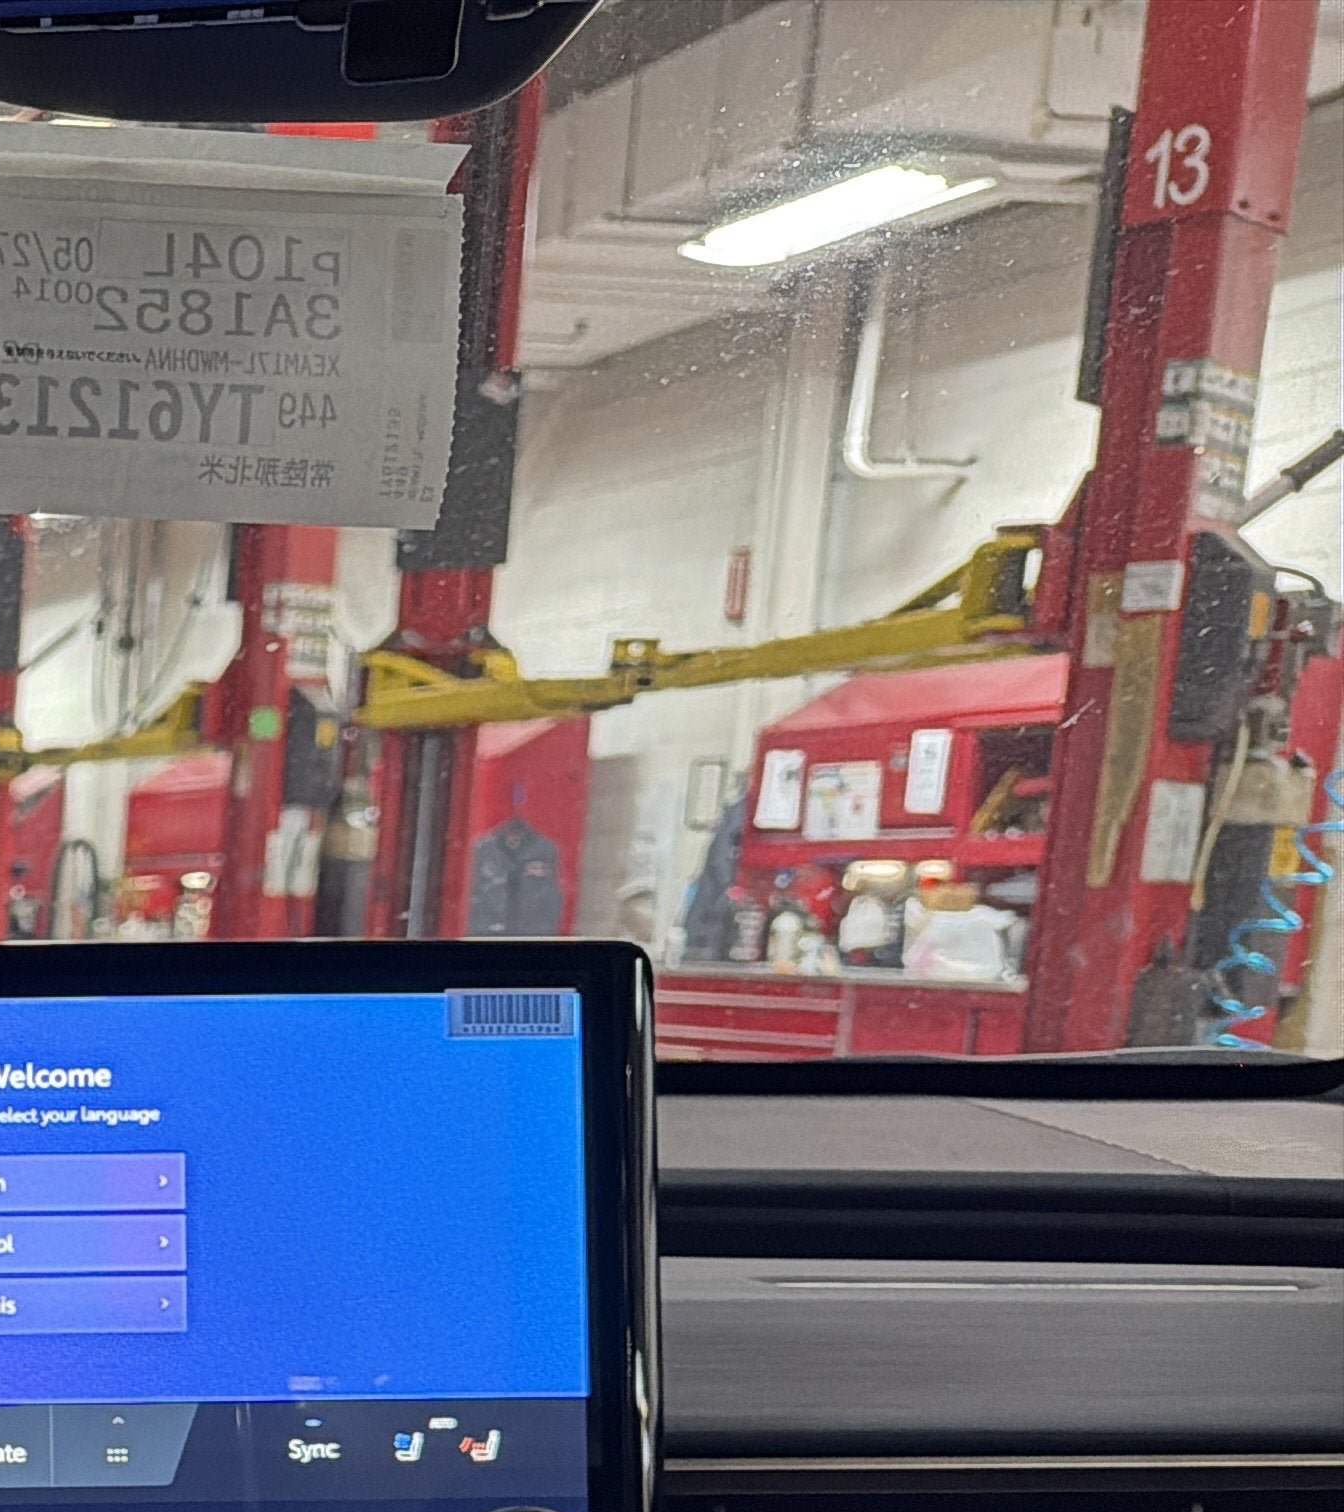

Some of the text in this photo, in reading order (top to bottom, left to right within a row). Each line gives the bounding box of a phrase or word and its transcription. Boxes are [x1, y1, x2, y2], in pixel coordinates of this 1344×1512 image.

[1144, 123, 1211, 209] 13
[41, 1109, 77, 1127] your
[80, 1106, 161, 1125] language
[288, 1438, 341, 1463] Sync
